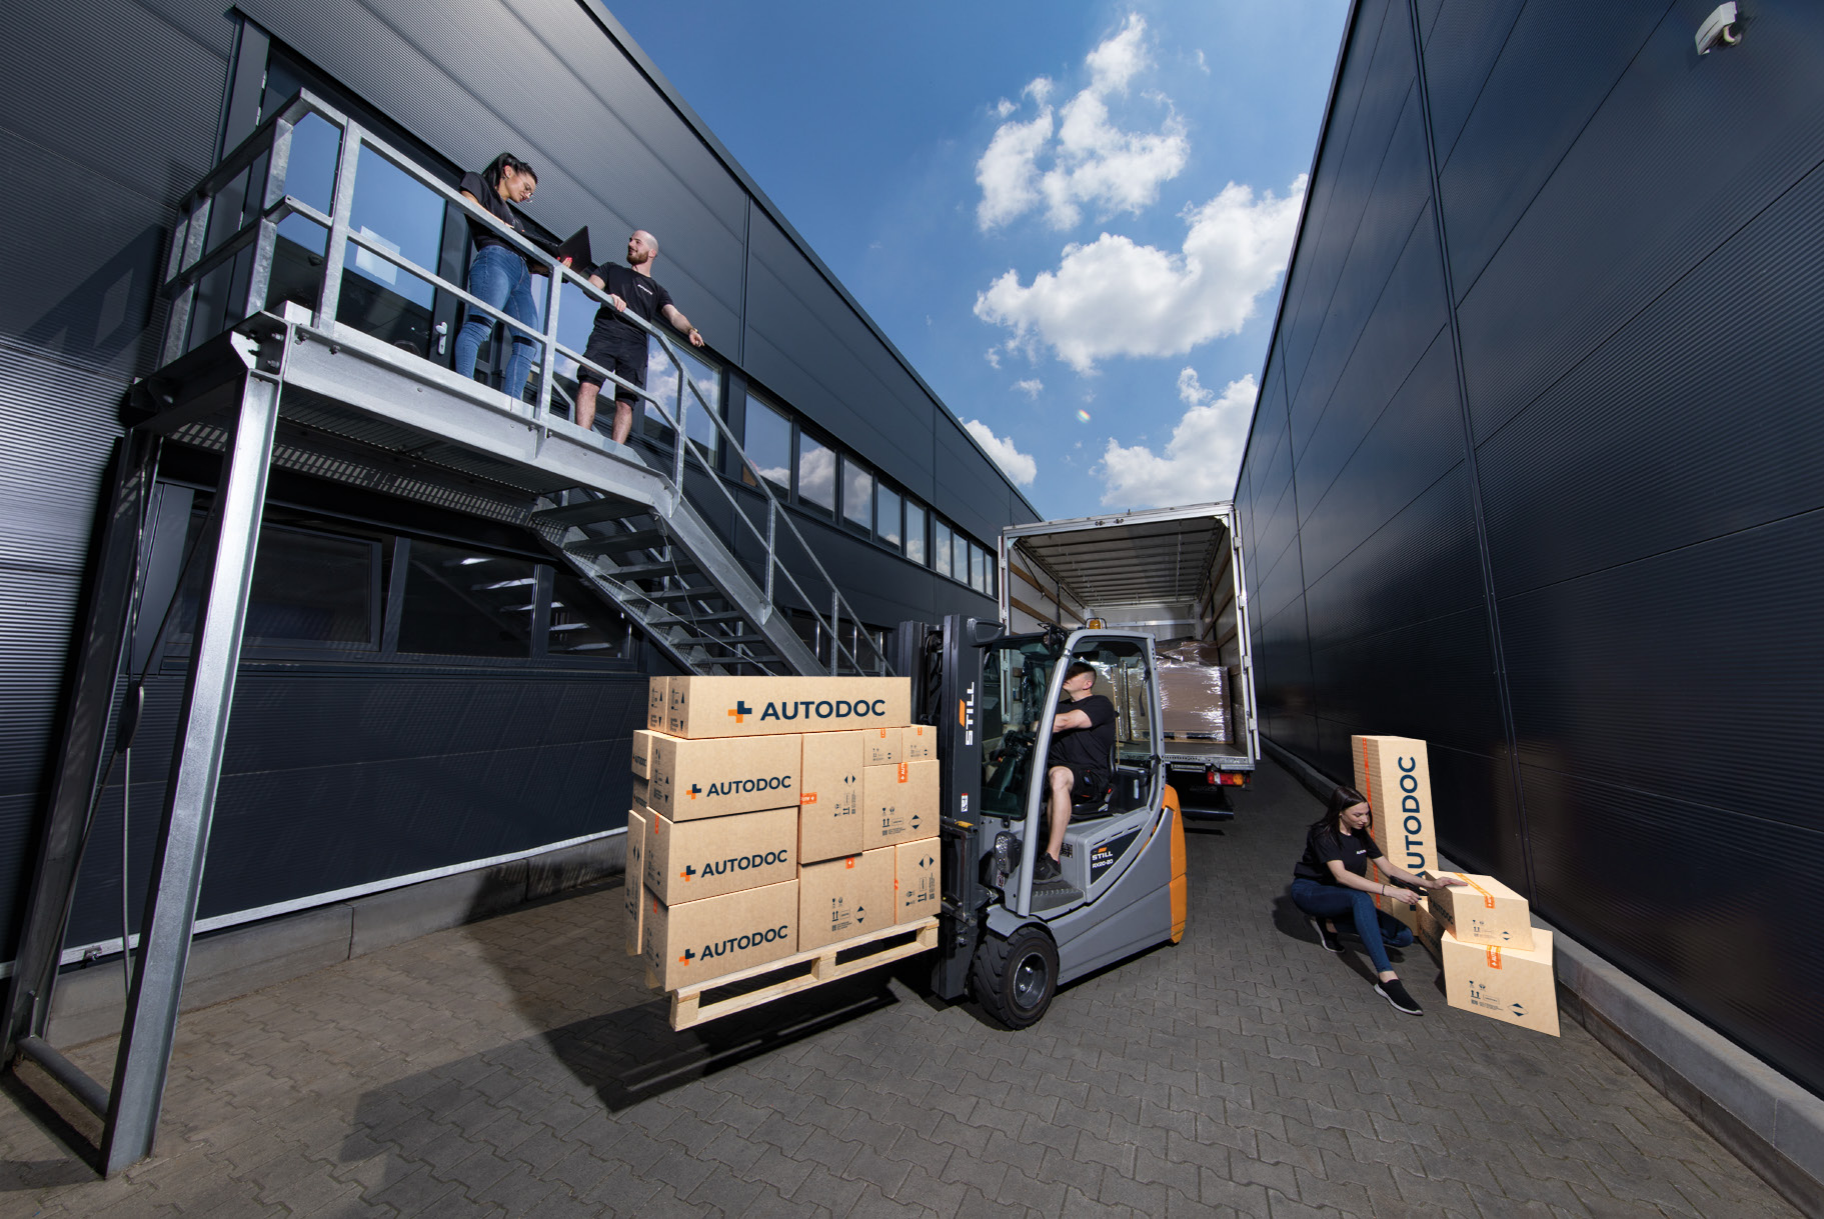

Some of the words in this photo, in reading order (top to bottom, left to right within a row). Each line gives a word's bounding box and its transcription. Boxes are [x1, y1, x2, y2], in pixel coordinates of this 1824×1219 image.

[760, 699, 886, 721] AUTODOC
[965, 681, 975, 746] STILL
[706, 775, 792, 797] AUTODOC
[700, 849, 788, 878] AUTODOC
[1091, 850, 1114, 861] STILL
[699, 925, 789, 961] AUTODOC
